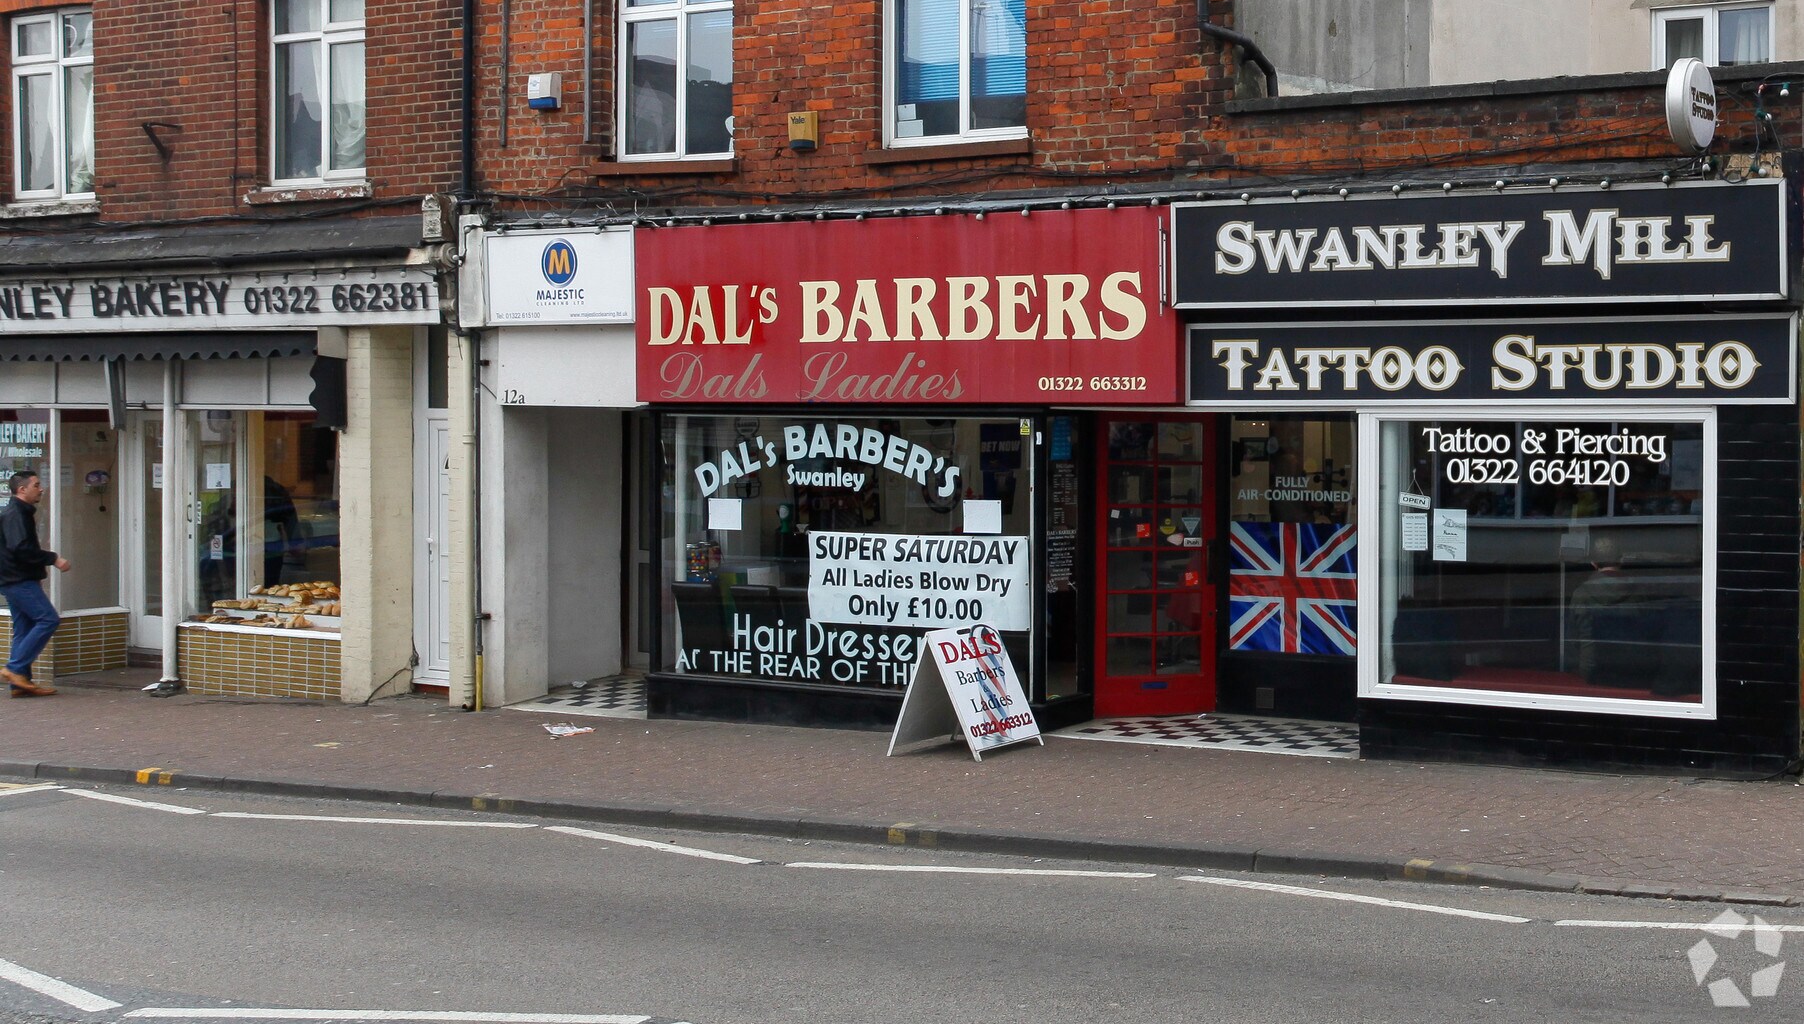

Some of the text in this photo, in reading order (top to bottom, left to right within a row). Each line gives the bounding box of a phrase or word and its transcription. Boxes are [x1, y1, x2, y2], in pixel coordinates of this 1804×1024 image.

[1691, 86, 1715, 106] TATTOO
[791, 116, 805, 124] Yale
[1692, 102, 1714, 121] STUDIO
[1215, 208, 1731, 280] SWANLEY MILL
[90, 281, 230, 317] BAKERY
[244, 286, 319, 315] 01322
[332, 282, 429, 312] 662381
[536, 288, 584, 300] MAJESTIC
[799, 270, 1147, 342] BARBERS
[1212, 334, 1762, 391] TATTOO STUDIO
[659, 351, 964, 401] Dals Ladies
[1037, 377, 1147, 391] 01322 663312
[504, 389, 525, 404] 12a
[16, 423, 47, 443] BAKERY
[1422, 427, 1666, 462] Tattoo & Piercing
[8, 446, 42, 458] Wholesale
[787, 463, 865, 492] Swanley
[1275, 476, 1310, 488] FULLY
[1446, 457, 1630, 486] 01322 664120
[1237, 489, 1351, 502] AIR-CONDITIONED
[1402, 496, 1426, 505] OPEN
[815, 535, 887, 562] SUPER
[893, 538, 1018, 565] SATURDAY
[822, 568, 1011, 597] All Ladies Blow Dry
[848, 594, 983, 622] Only £10.00
[734, 613, 797, 653] Hair
[710, 650, 752, 673] THE
[760, 653, 820, 679] REAR
[831, 659, 868, 683] OF
[956, 666, 1006, 685] Barbers
[970, 694, 1014, 713] Ladies
[970, 712, 1033, 738] 01322 663312
